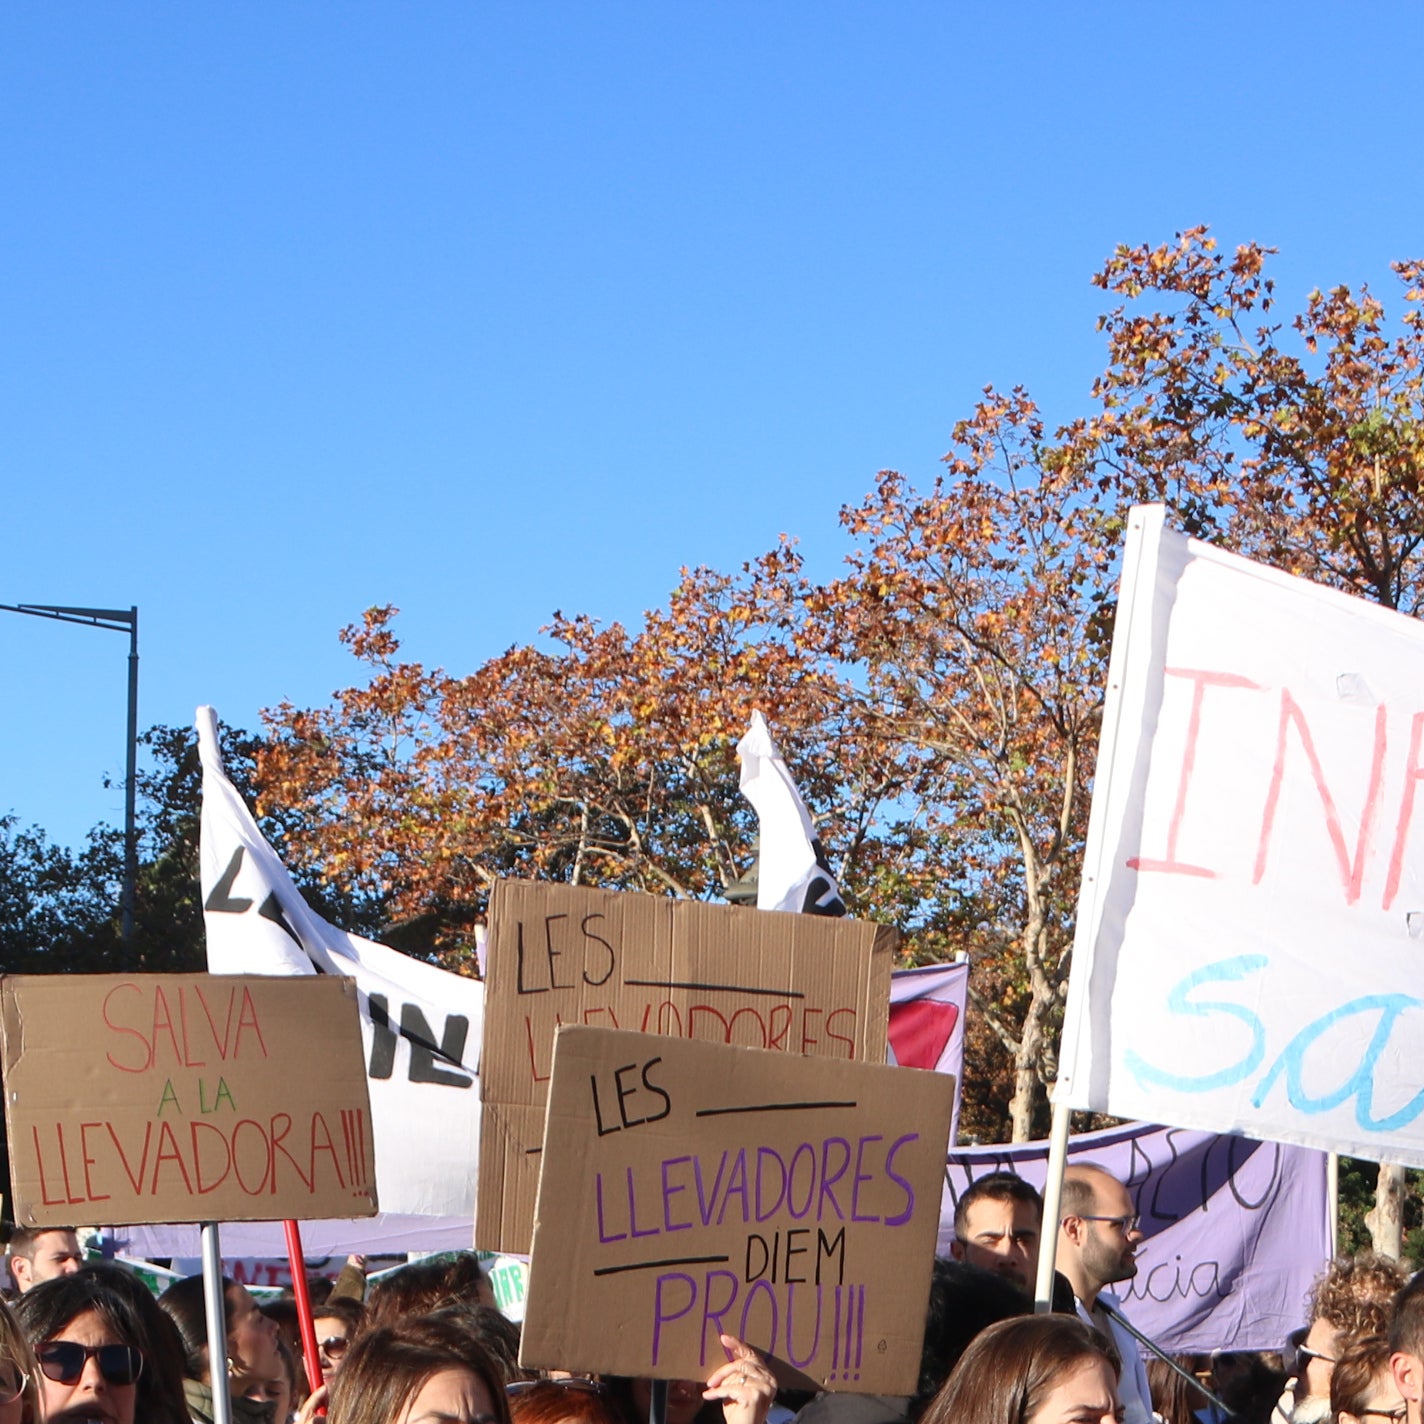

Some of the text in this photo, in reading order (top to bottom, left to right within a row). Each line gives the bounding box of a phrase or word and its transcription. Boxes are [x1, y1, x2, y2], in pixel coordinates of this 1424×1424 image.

[516, 914, 615, 994] LES
[103, 982, 268, 1073] SALVA
[157, 1076, 237, 1117] A LA
[591, 1057, 672, 1137] LES
[32, 1109, 372, 1206] LLEVADORA!!!
[595, 1133, 919, 1244] LLEVADORES
[745, 1227, 846, 1285] DIEM
[651, 1270, 866, 1381] PROU!!!
